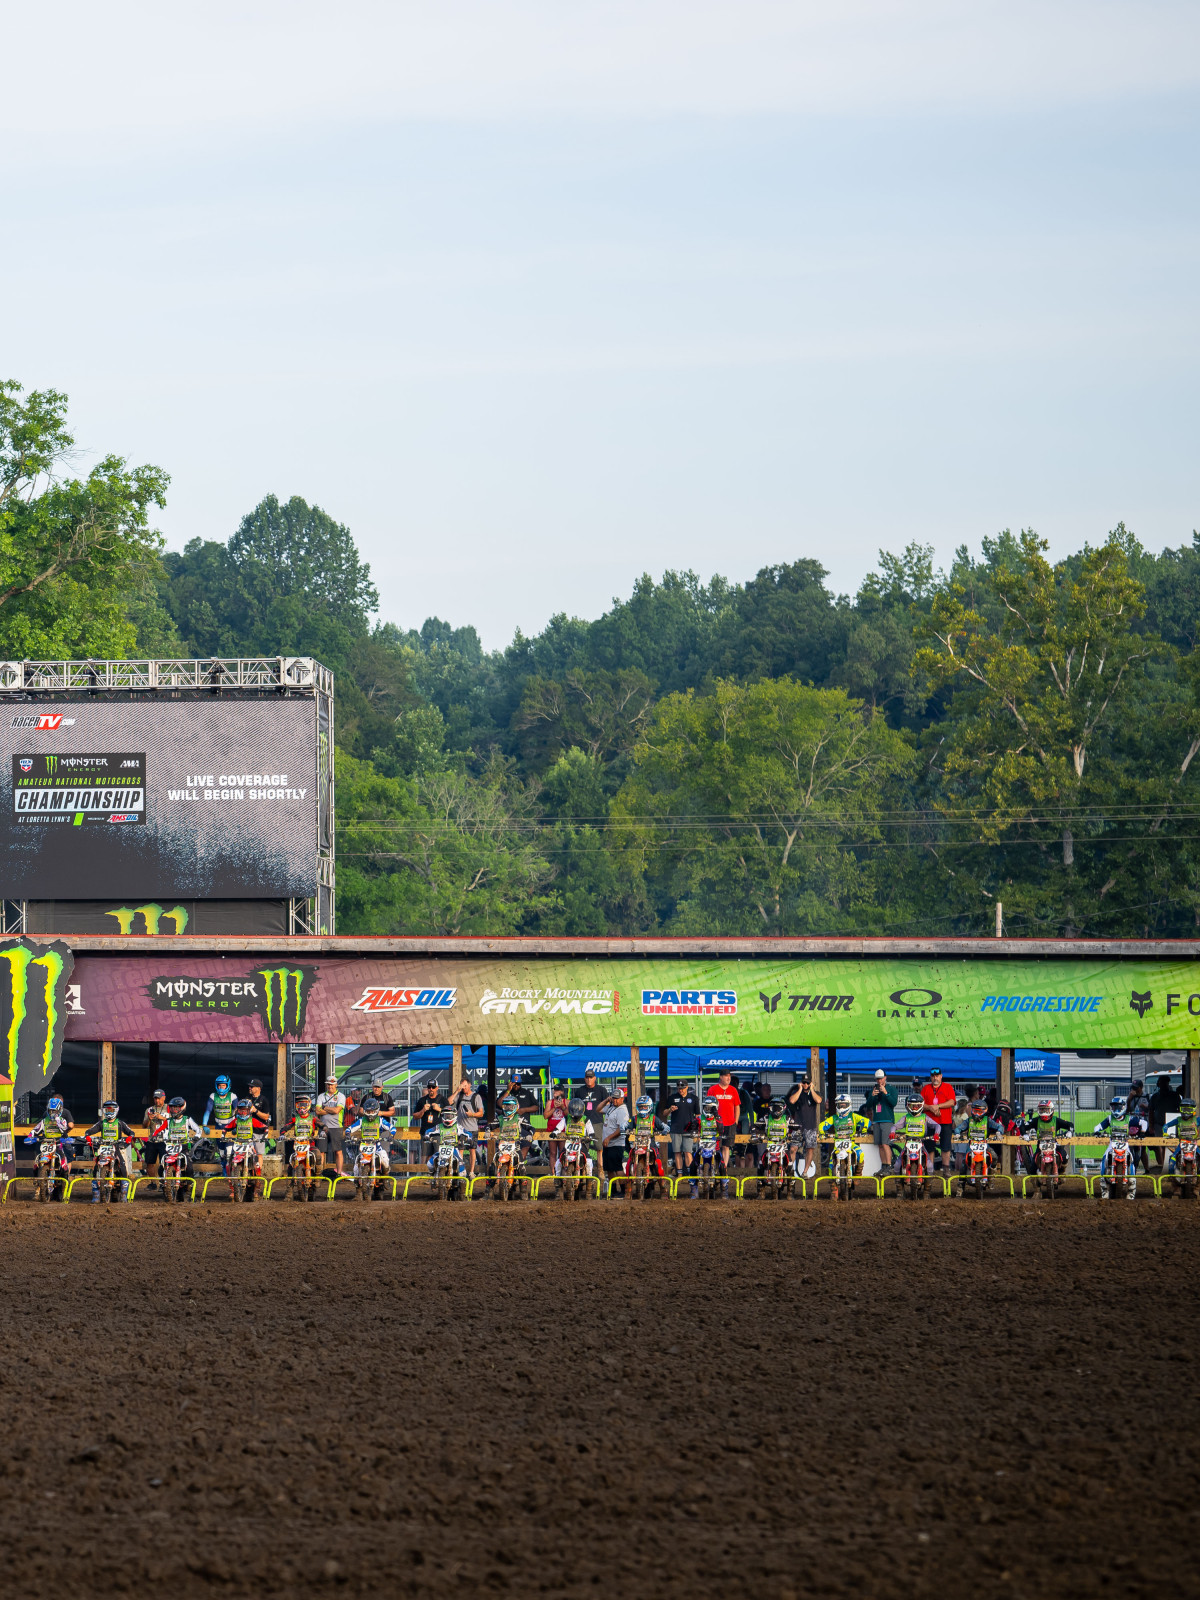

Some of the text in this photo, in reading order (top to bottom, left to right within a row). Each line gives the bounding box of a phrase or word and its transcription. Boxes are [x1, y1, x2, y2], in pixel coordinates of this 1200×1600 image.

[60, 757, 109, 767] MONSTER
[17, 776, 142, 787] AMATEUR NATIONAL MOTOCROSS
[186, 775, 288, 787] LIVE COVERAGE
[17, 790, 141, 810] CHAMPIONSHIP
[167, 788, 307, 801] WILL BEGIN SHORTLY
[108, 814, 140, 823] AMSOIL
[156, 979, 259, 999] MONSTER
[500, 988, 613, 1000] ROCKY MOUNTAIN
[356, 989, 456, 1010] AMSOIL
[642, 990, 736, 1004] PARTS
[170, 1000, 241, 1008] ENERGY
[787, 995, 856, 1011] THOR
[980, 995, 1104, 1013] PROGRESSIVE
[642, 1005, 736, 1014] UNLIMITED
[876, 1009, 957, 1018] OAKLEY
[42, 1145, 53, 1153] 38
[836, 1141, 849, 1149] 48
[440, 1147, 452, 1155] 86
